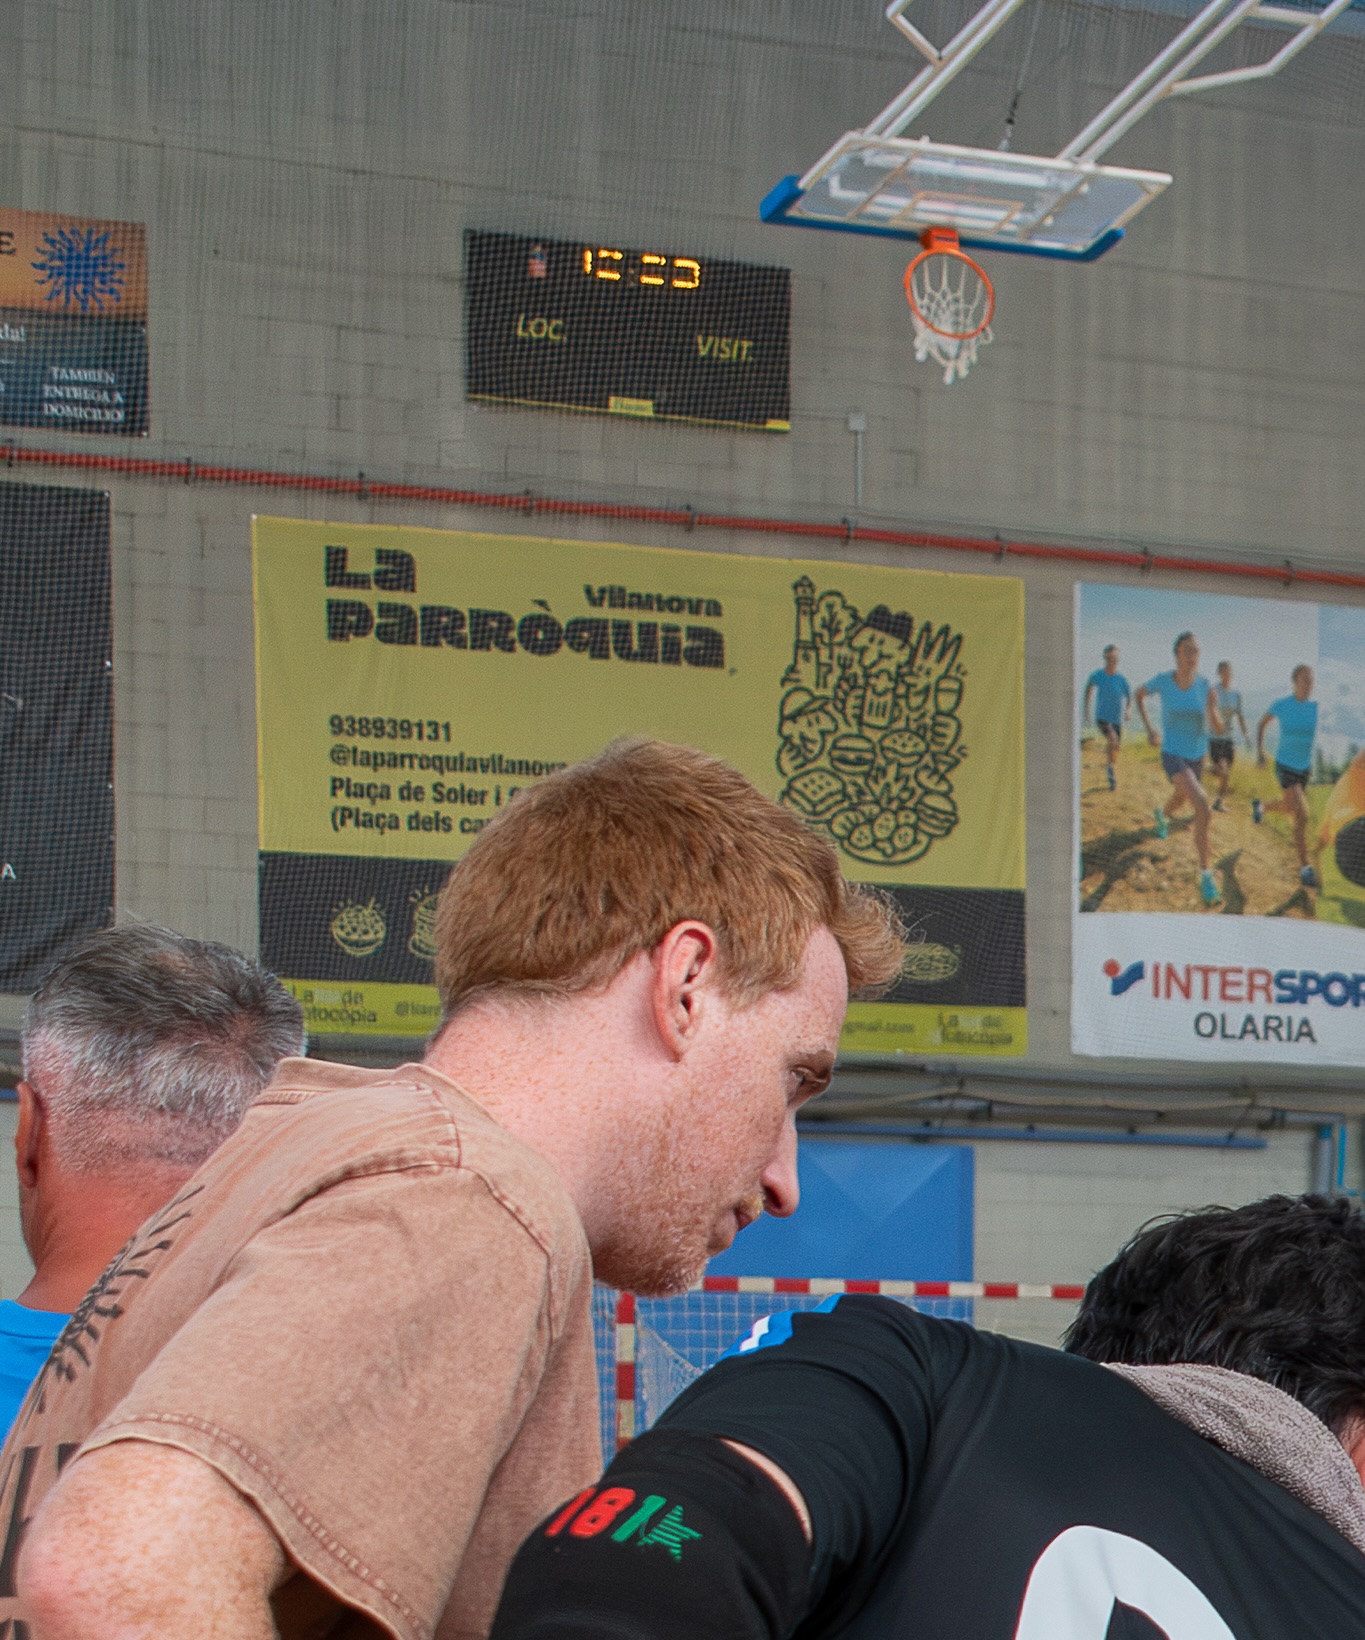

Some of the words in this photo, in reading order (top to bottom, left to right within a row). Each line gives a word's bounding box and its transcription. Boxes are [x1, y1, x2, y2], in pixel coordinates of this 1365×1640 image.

[325, 545, 416, 593] La
[583, 584, 722, 617] Vilanova
[329, 775, 392, 806] Plaça
[397, 780, 426, 802] de
[431, 780, 488, 806] Soler
[330, 804, 401, 835] (Plaça
[406, 809, 453, 833] dels
[1193, 1011, 1319, 1043] OLARIA
